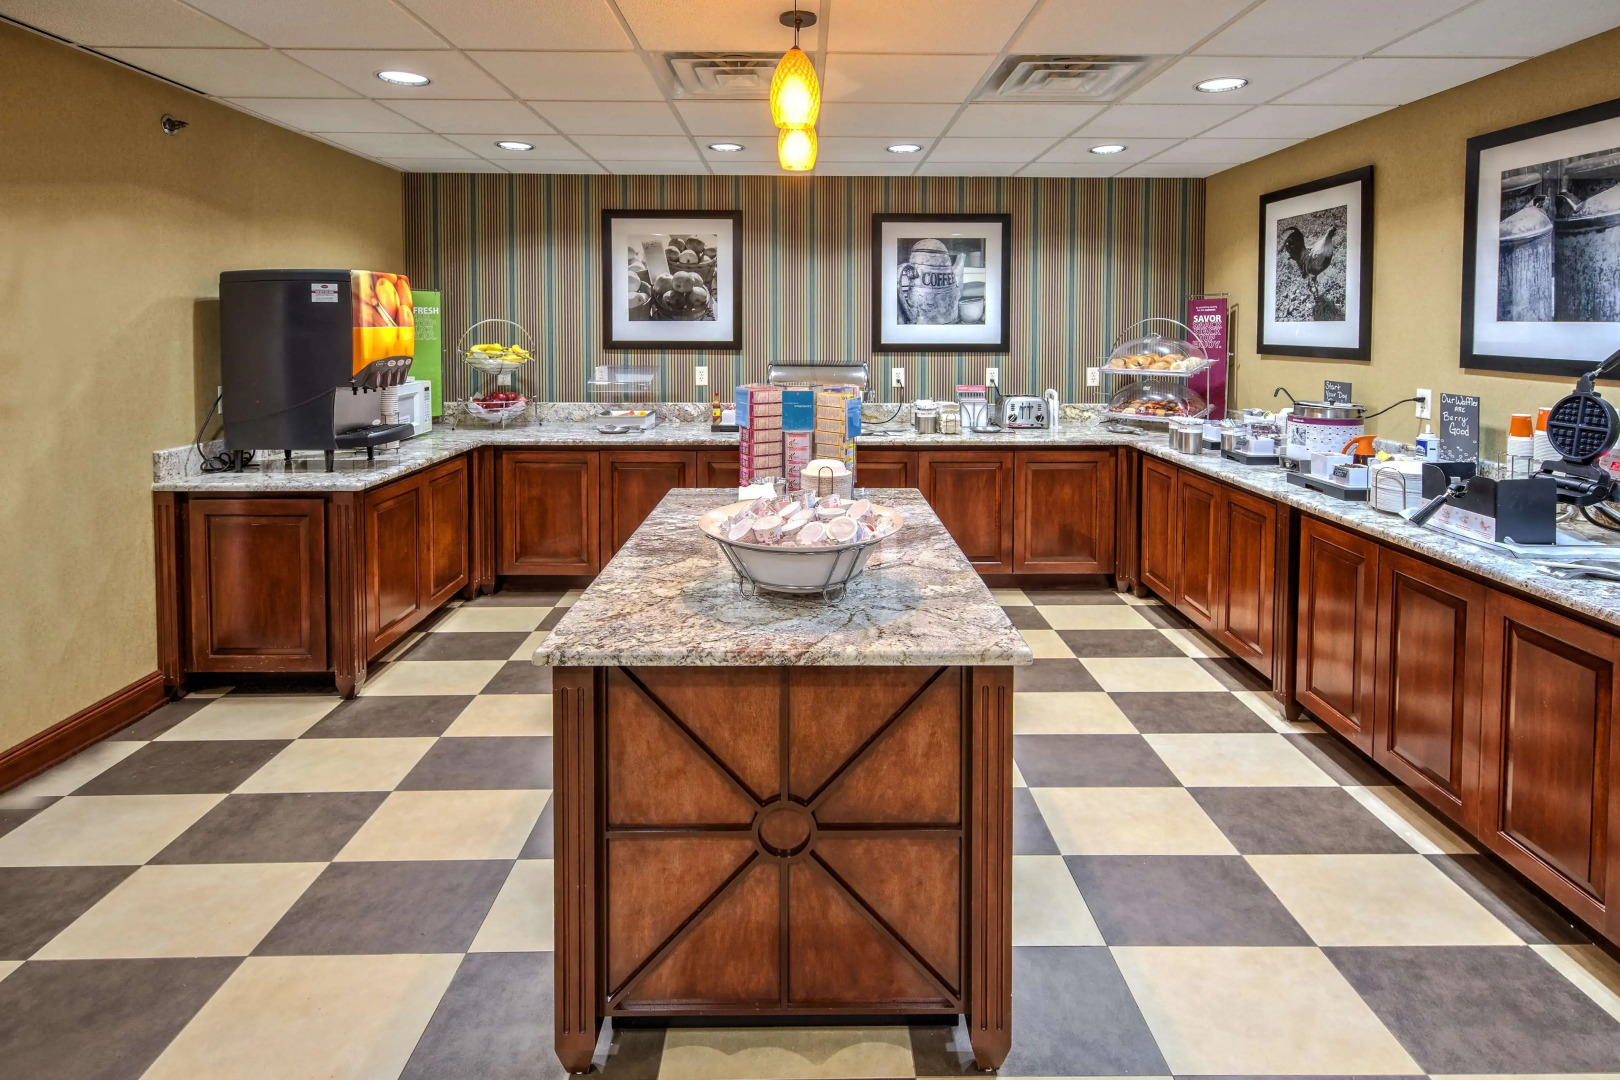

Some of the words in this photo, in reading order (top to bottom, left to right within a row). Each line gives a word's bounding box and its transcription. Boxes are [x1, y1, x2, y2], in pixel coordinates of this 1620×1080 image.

[1326, 382, 1342, 390] Start
[1338, 391, 1348, 401] Day
[1442, 394, 1456, 404] Our
[1456, 396, 1478, 406] Waffles
[1442, 412, 1468, 427] Berry
[1449, 422, 1469, 436] Good
